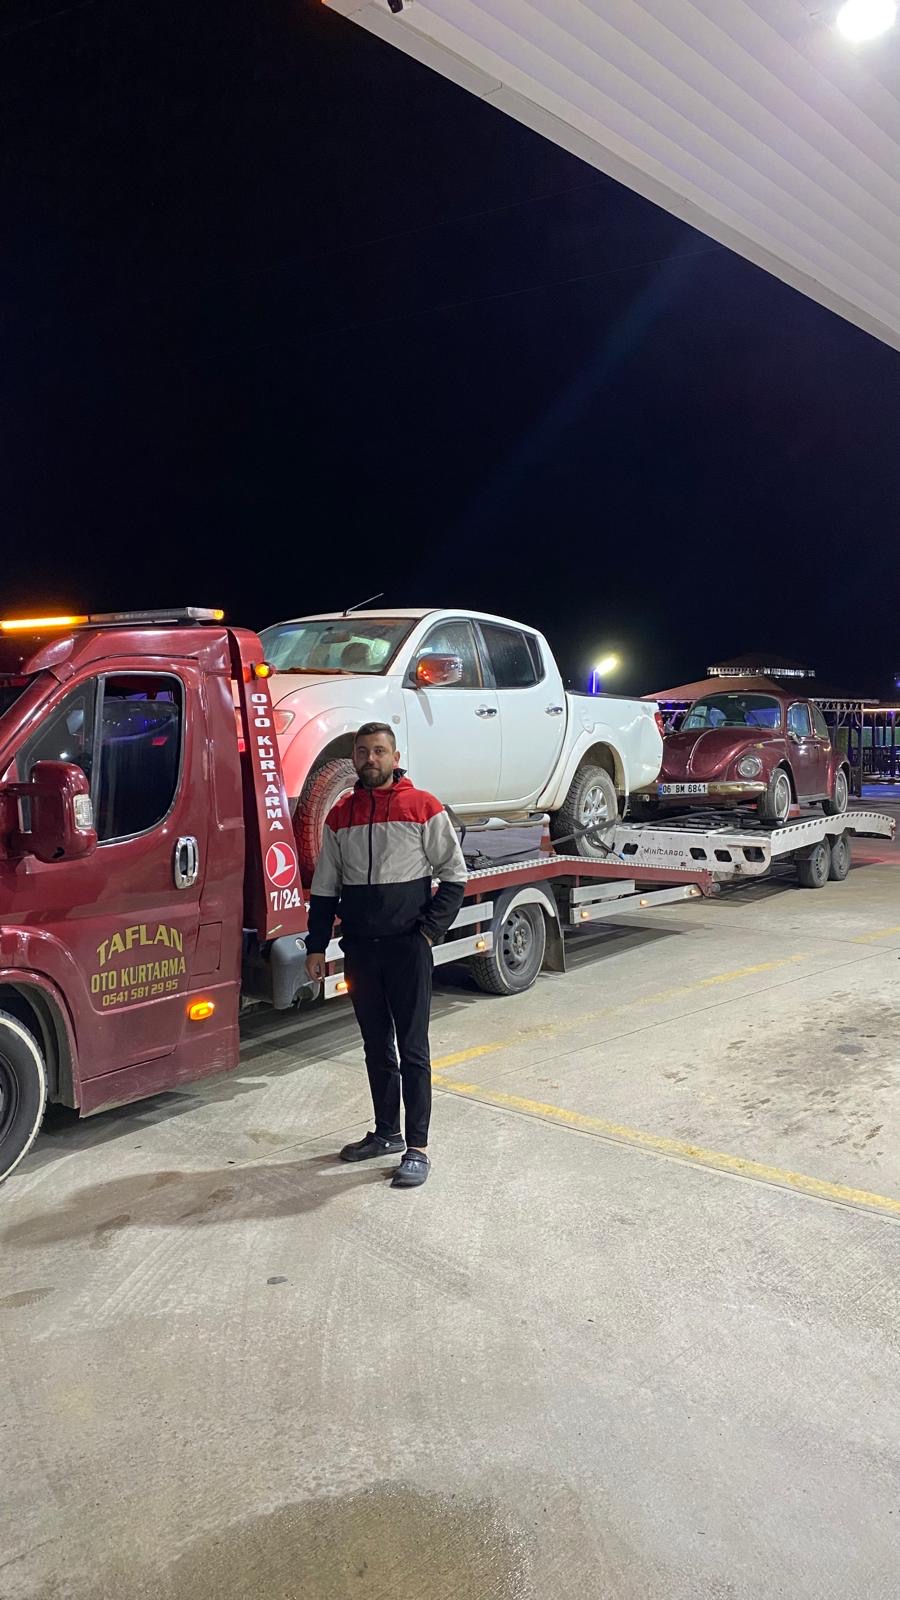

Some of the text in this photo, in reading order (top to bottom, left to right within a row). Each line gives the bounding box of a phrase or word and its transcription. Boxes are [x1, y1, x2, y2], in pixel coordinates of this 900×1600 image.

[251, 693, 284, 831] OTO KURTARMA
[662, 784, 672, 794] 06
[687, 784, 706, 793] 6841
[270, 887, 301, 911] 7/24
[97, 924, 183, 967] TAFLAN
[91, 956, 186, 993] OTO KURTARMA
[102, 979, 179, 1007] 0541 581 29 95
